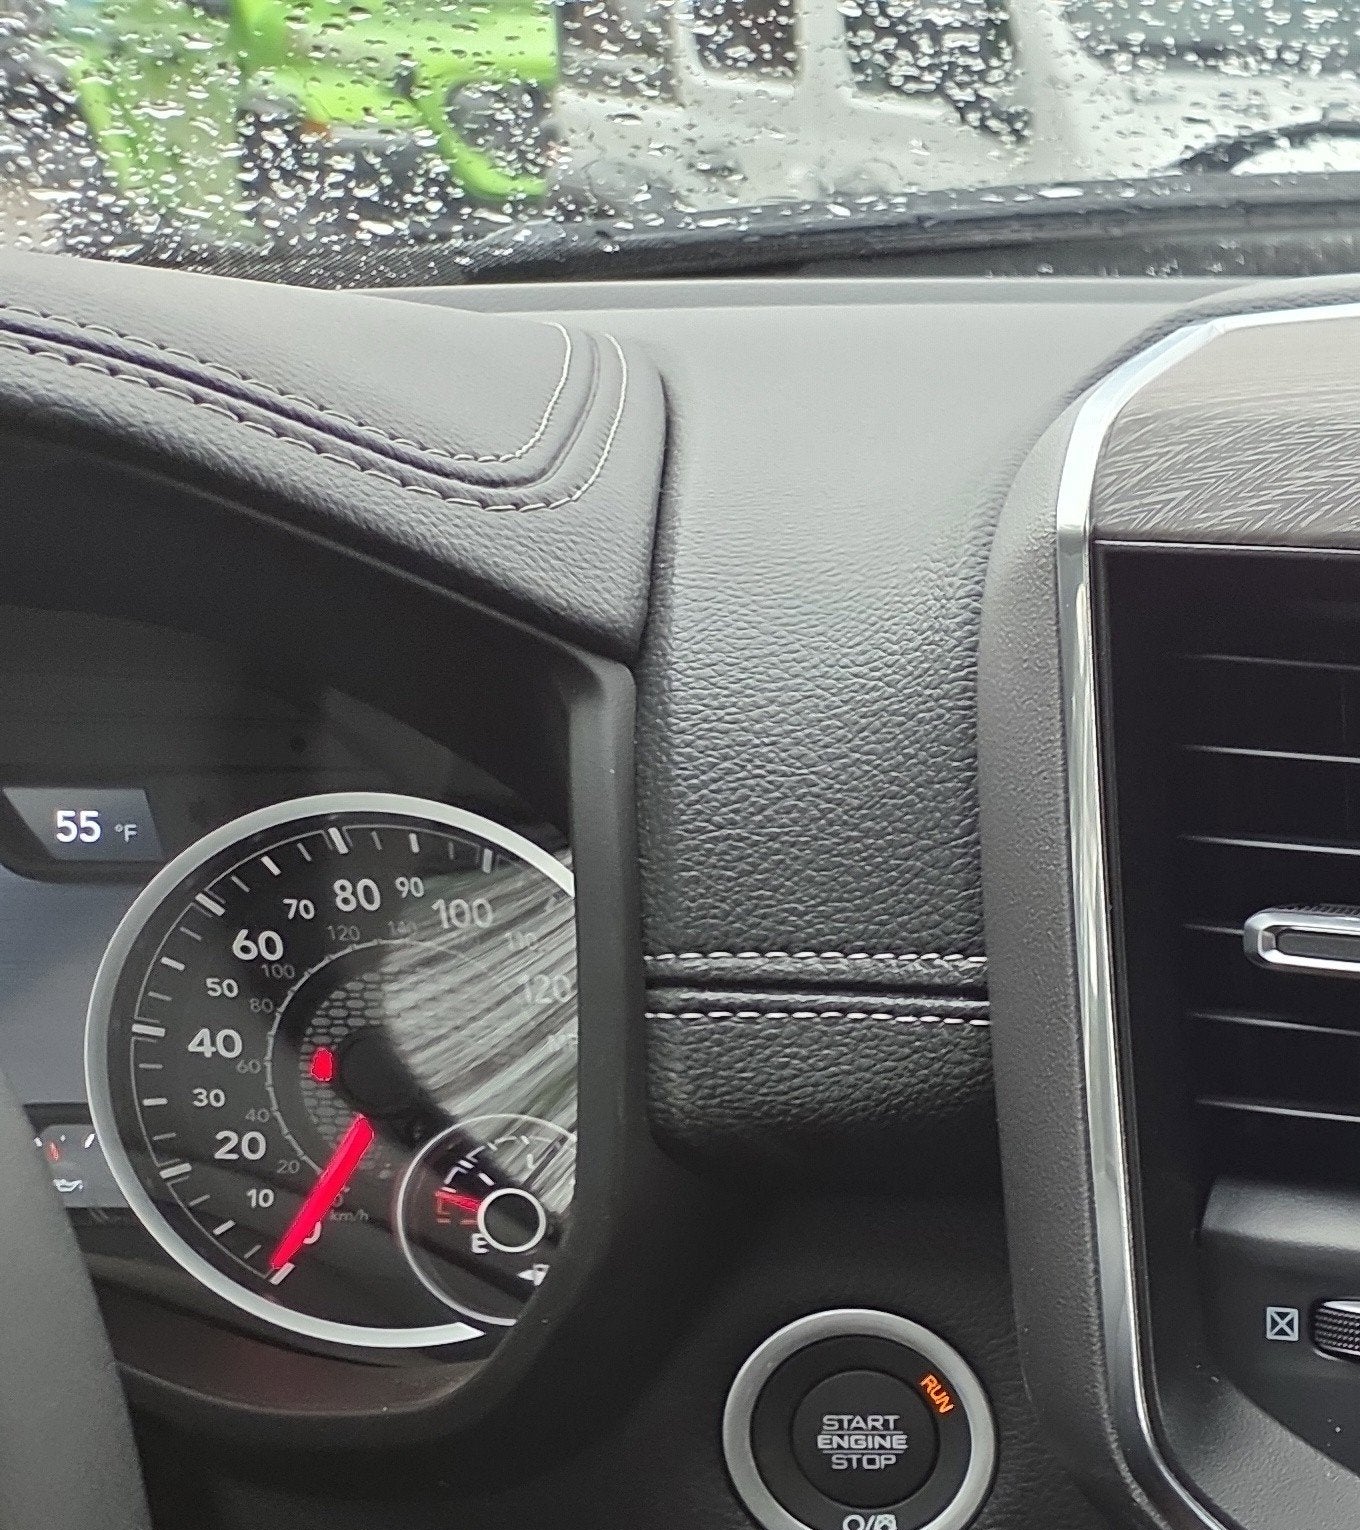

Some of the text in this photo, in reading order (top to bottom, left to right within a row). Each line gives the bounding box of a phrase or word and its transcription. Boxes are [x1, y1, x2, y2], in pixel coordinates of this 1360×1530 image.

[55, 810, 102, 843] 55
[333, 878, 381, 912] 80
[395, 876, 425, 898] 90
[282, 898, 315, 920] 70
[431, 898, 494, 929] 100
[327, 923, 361, 942] 120
[232, 928, 284, 961] 60
[261, 962, 295, 980] 100
[205, 977, 239, 998] 50
[187, 1028, 243, 1059] 40
[236, 1057, 263, 1075] 60
[191, 1088, 226, 1109] 30
[213, 1130, 267, 1161] 20
[277, 1159, 301, 1174] 20
[246, 1188, 275, 1209] 10
[919, 1373, 955, 1415] RUN
[822, 1414, 900, 1431] START
[816, 1433, 908, 1450] ENGINE
[830, 1454, 897, 1470] STOP
